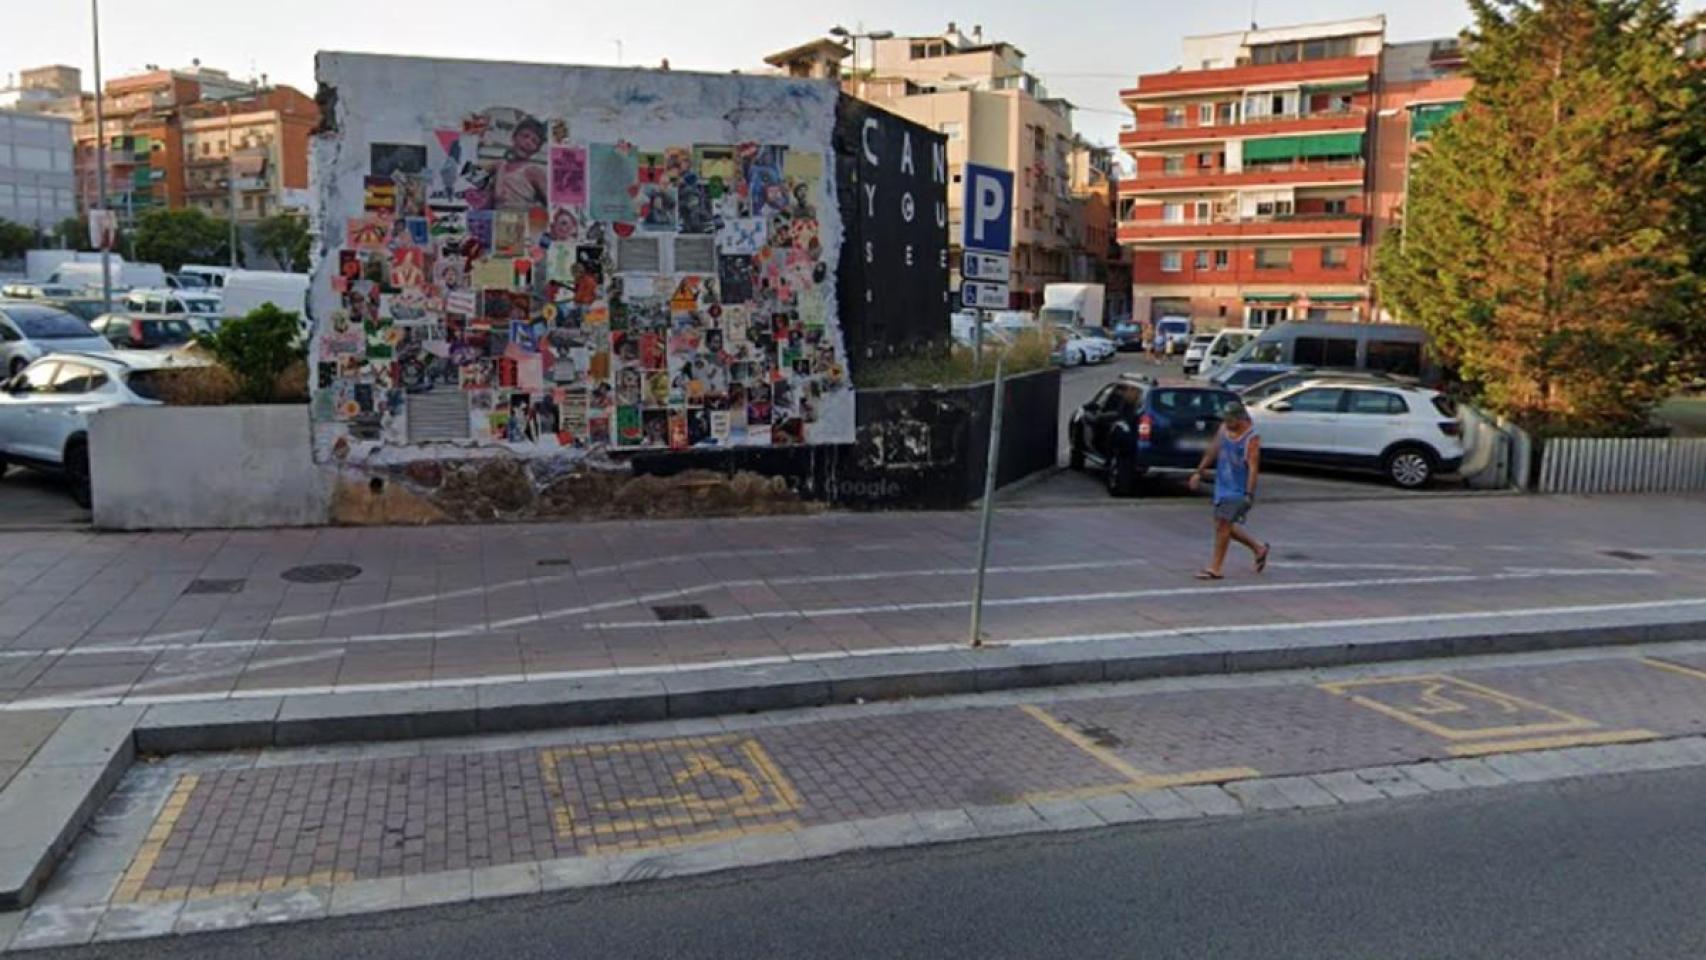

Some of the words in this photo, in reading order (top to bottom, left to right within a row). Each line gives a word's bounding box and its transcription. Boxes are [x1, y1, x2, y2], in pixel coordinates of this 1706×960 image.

[863, 117, 945, 185] CAN
[973, 174, 1006, 241] P
[865, 240, 948, 269] SEE
